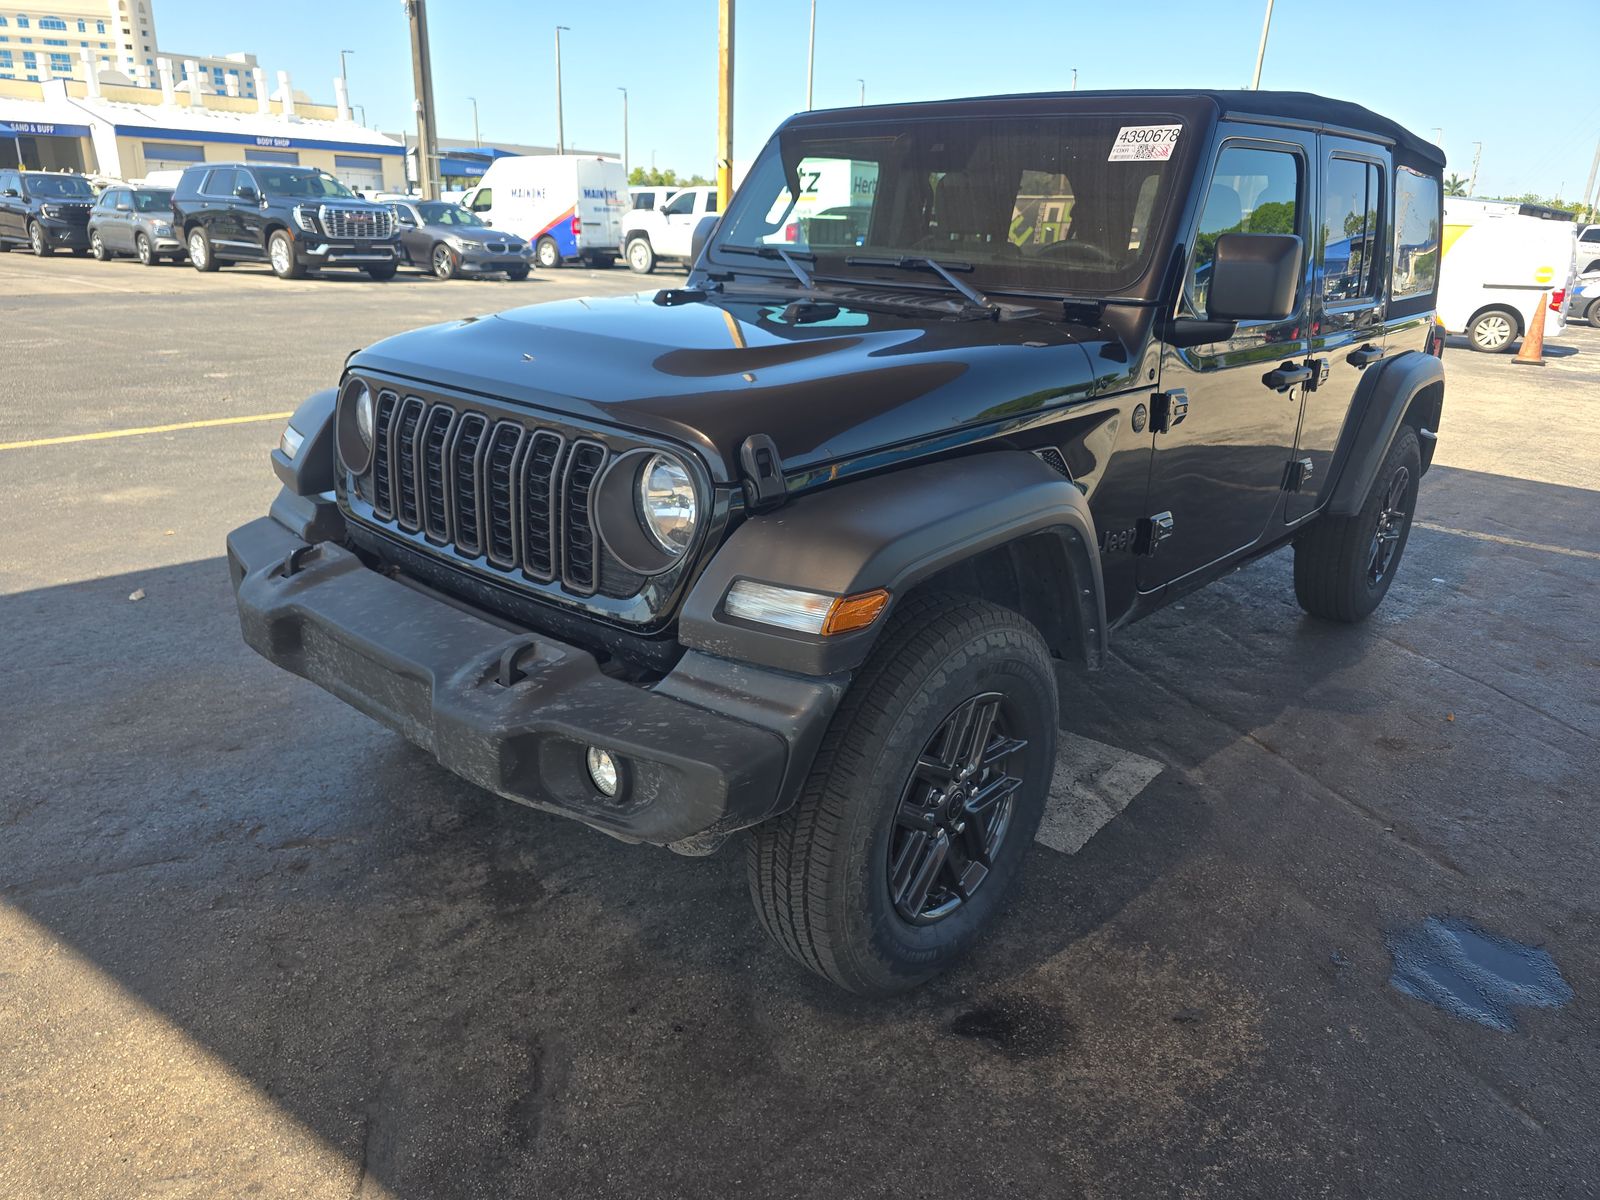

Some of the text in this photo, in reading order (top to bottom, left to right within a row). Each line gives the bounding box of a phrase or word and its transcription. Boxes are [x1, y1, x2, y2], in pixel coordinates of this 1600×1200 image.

[10, 122, 55, 134] SAND & BUFF
[256, 136, 290, 147] BODY SHOP
[1119, 128, 1181, 143] 4390678
[1099, 526, 1137, 553] Jeep
